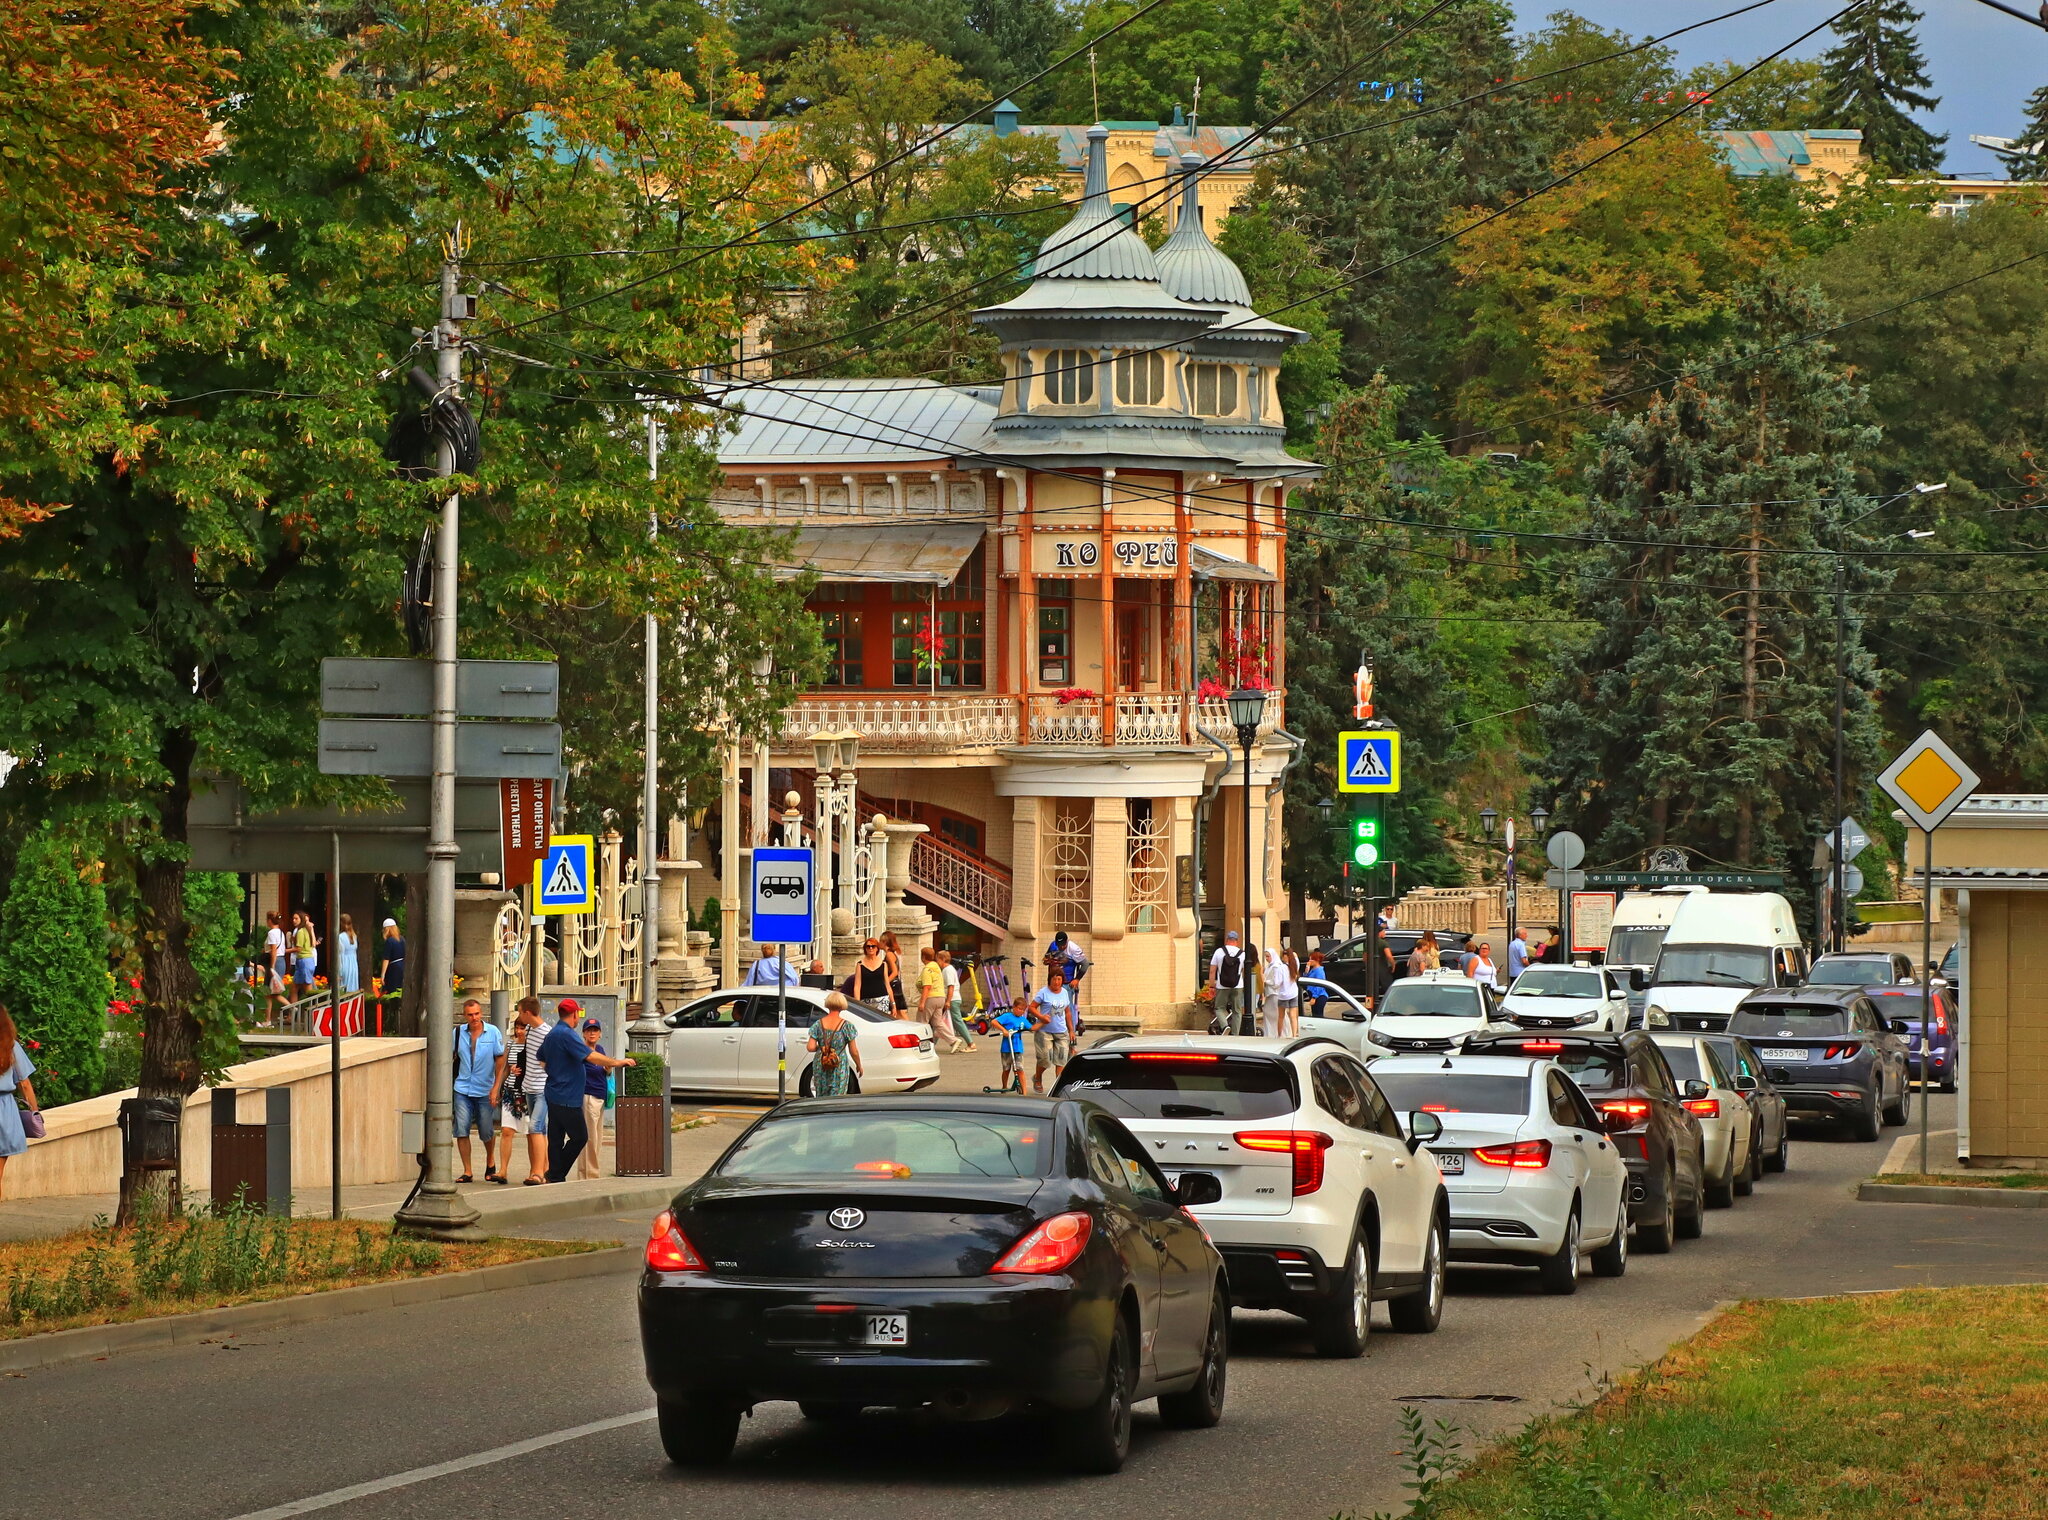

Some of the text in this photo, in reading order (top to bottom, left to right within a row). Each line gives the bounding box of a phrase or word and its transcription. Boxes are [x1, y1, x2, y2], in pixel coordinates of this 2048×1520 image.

[1056, 541, 1098, 567] КО
[509, 778, 522, 849] PERETTA THEATRE
[533, 778, 544, 850] ЕАТР ОПЕРЕТТЫ
[1585, 874, 1753, 883] АФИША ПЯТИГОРСКА
[1154, 1139, 1230, 1151] VAL
[1440, 1155, 1461, 1166] 126
[1255, 1186, 1275, 1194] 4WD
[815, 1238, 876, 1248] Solara
[867, 1317, 900, 1335] 126
[874, 1334, 891, 1342] RUS
